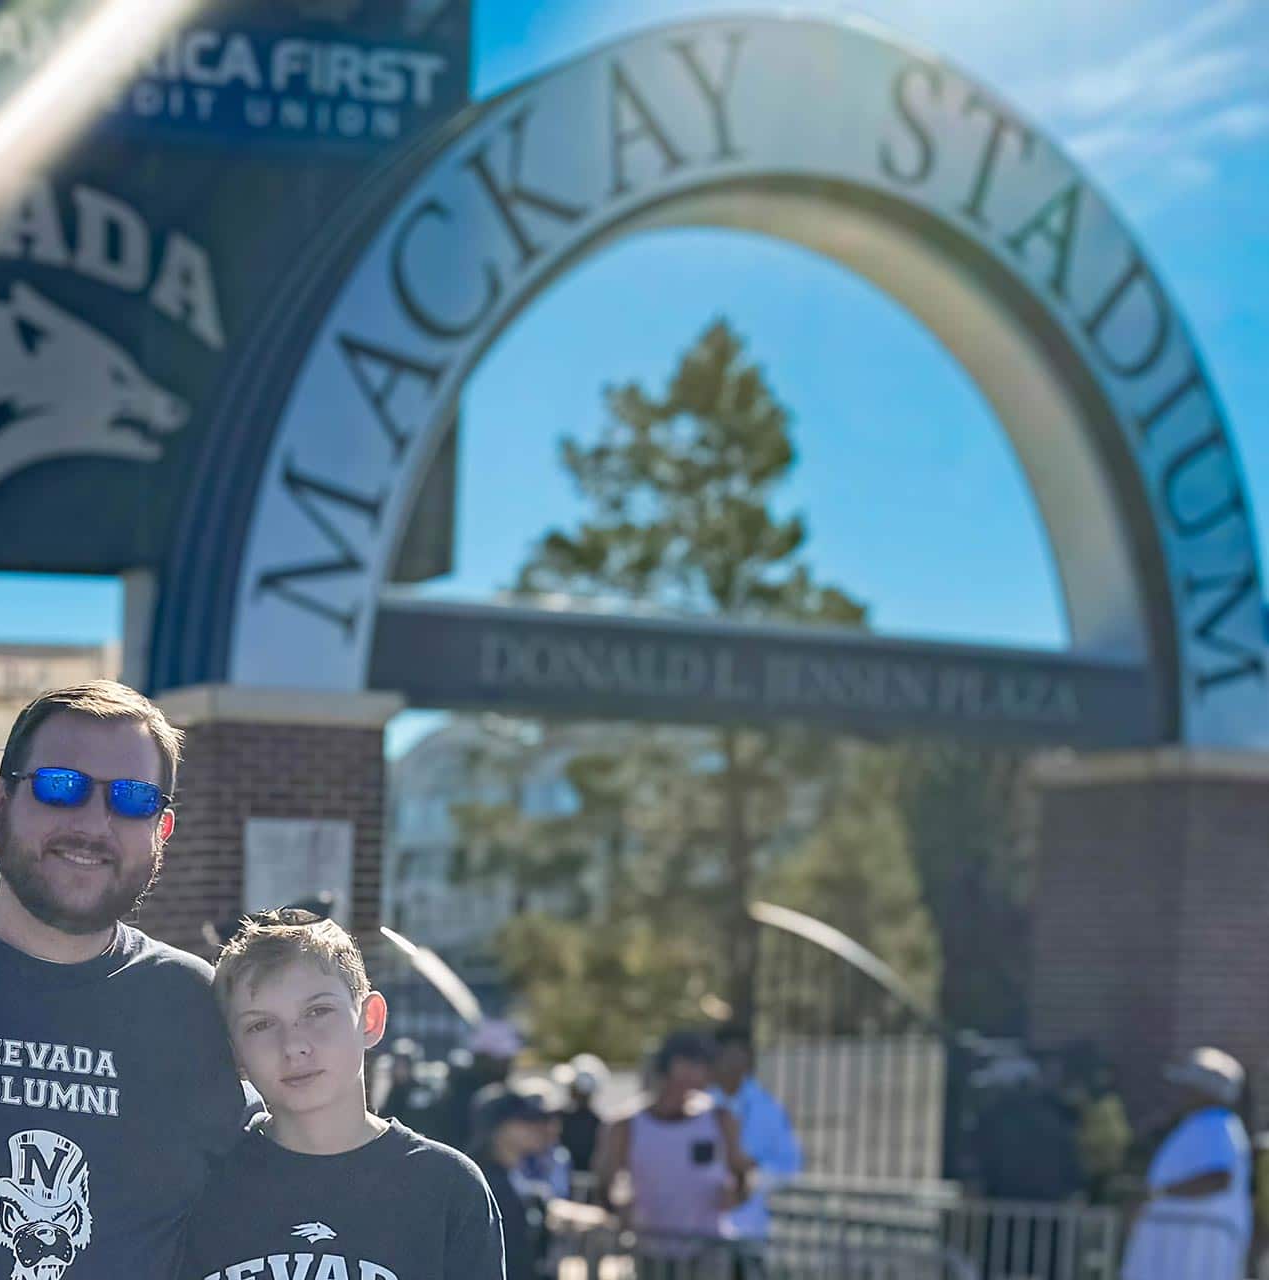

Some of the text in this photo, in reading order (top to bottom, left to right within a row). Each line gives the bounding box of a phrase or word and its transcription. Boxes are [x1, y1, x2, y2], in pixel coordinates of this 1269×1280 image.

[270, 38, 445, 105] FIRST
[244, 95, 401, 138] UNION
[259, 34, 1269, 697] MACKAY STADIUM
